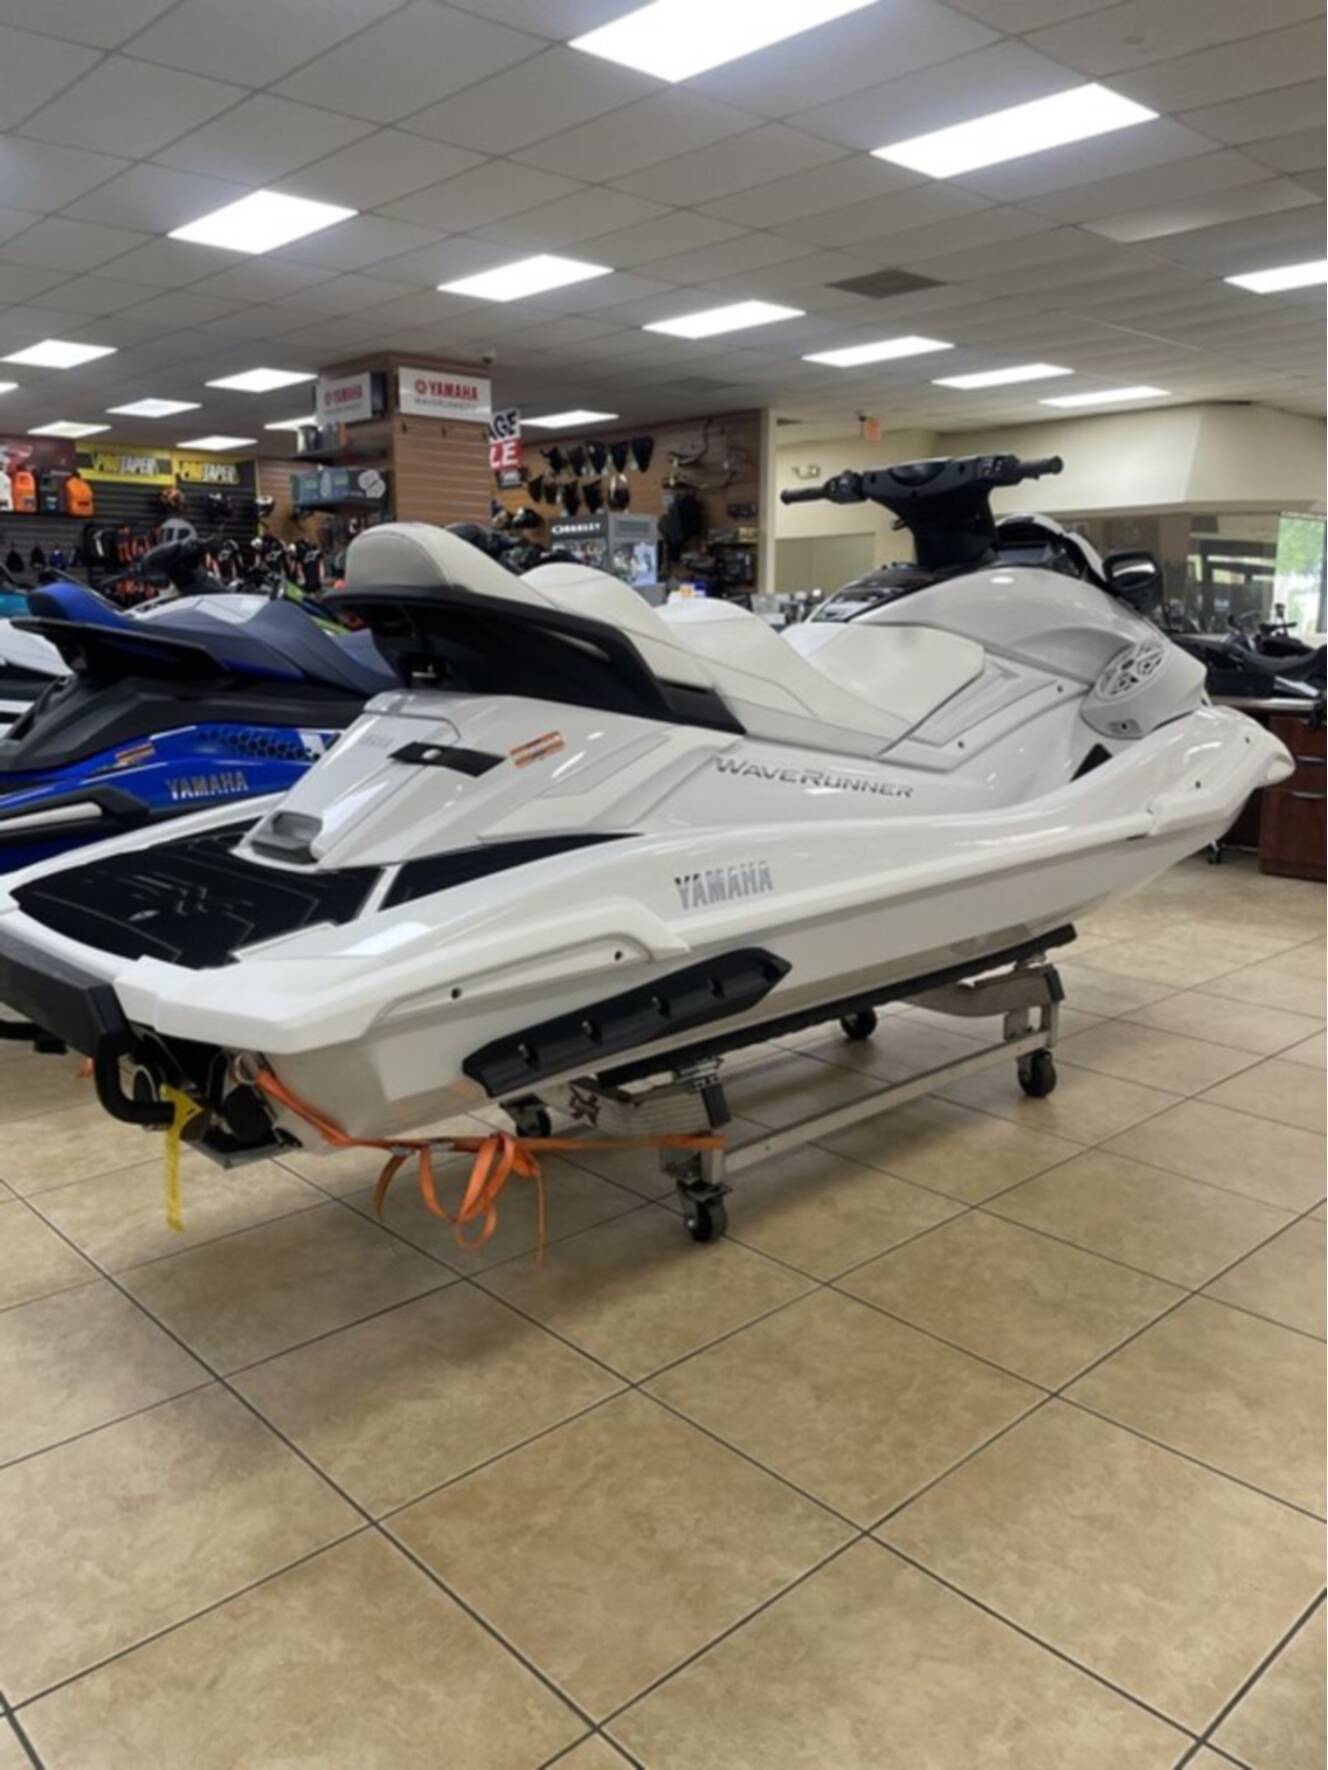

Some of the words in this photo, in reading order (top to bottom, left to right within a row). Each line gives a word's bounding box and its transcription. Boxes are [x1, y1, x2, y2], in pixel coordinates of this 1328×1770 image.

[427, 380, 479, 401] YAMAHA
[165, 770, 249, 800] YAMAHA
[714, 756, 914, 799] WAVERUNNER
[674, 860, 774, 910] YAMAHA
